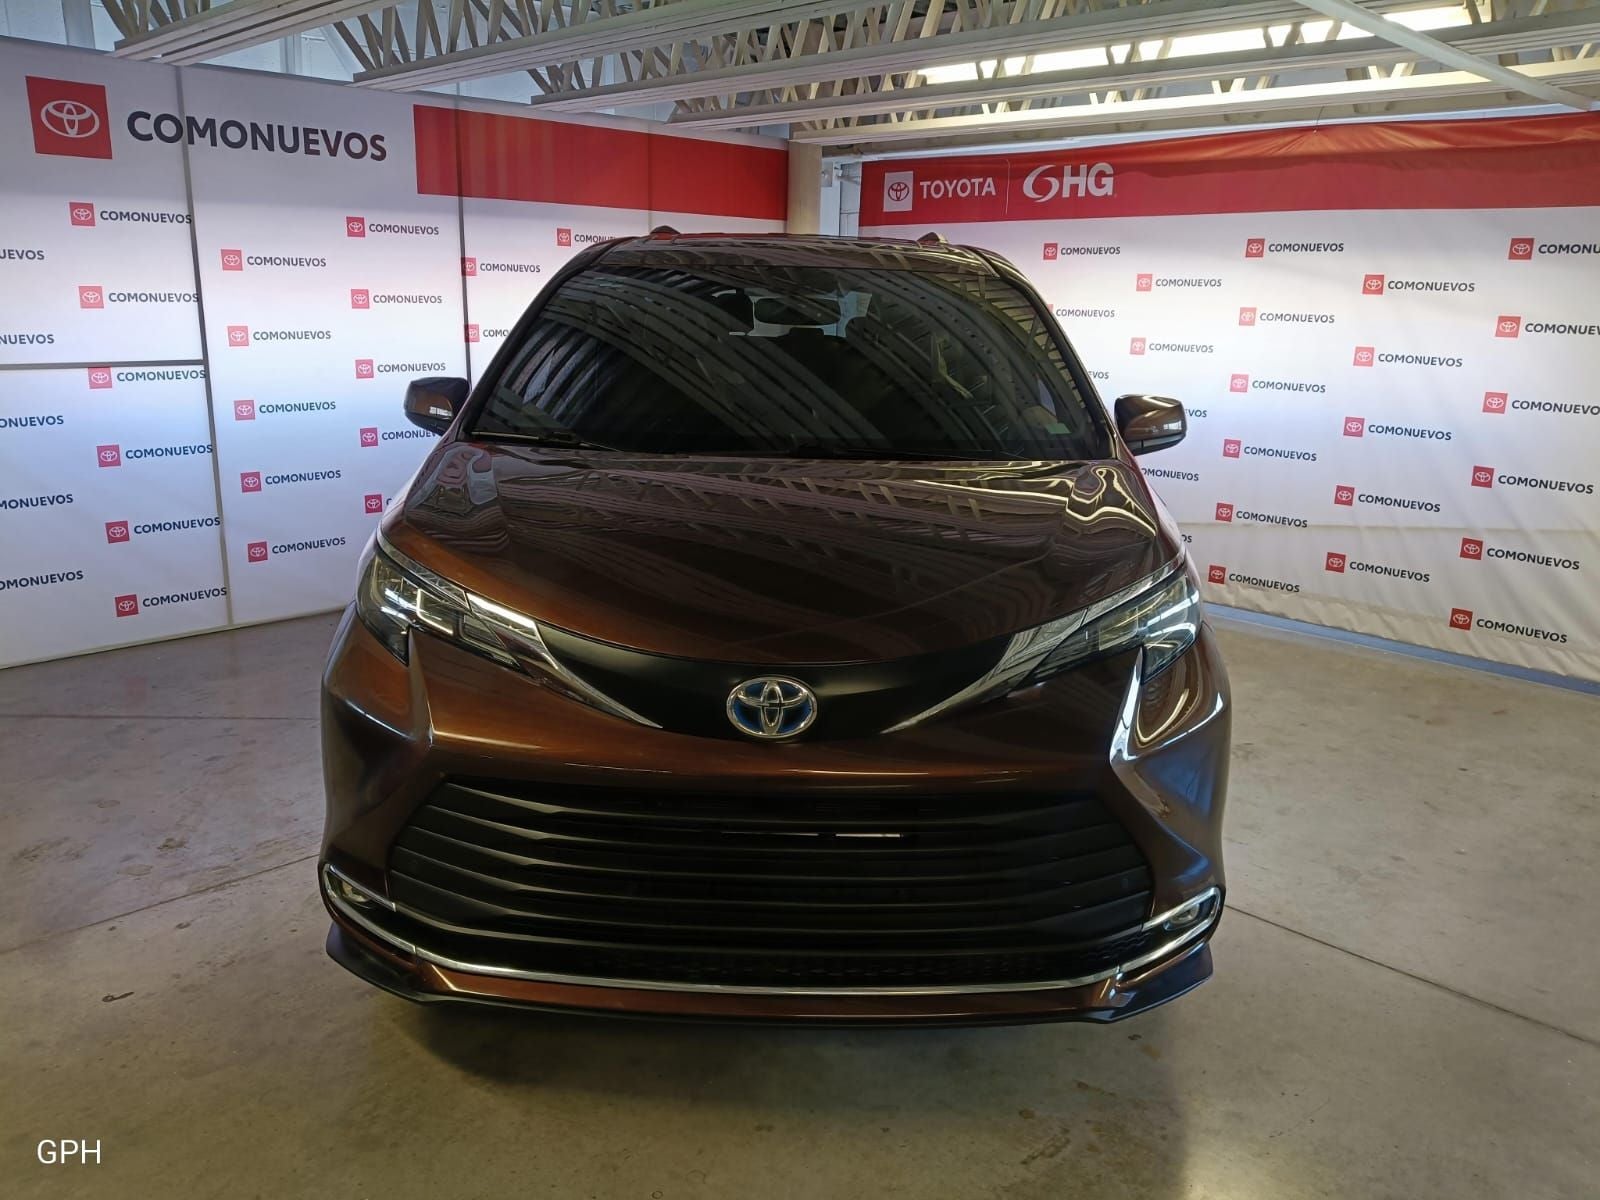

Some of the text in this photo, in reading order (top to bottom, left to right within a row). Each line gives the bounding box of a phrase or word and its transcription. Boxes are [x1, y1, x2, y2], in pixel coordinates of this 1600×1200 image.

[127, 111, 387, 161] COMONUEVOS
[920, 177, 996, 199] TOYOTA
[100, 210, 192, 224] COMONUEVOS
[368, 223, 440, 236] COMONUEVOS
[1060, 246, 1121, 256] COMONUEVOS
[1268, 242, 1345, 253] COMONUEVOS
[246, 255, 327, 268] COMONUEVOS
[479, 262, 541, 273] COMONUEVOS
[1155, 278, 1222, 288] COMONUEVOS
[1387, 280, 1475, 292] COMONUEVOS
[108, 292, 199, 303] COMONUEVOS
[372, 294, 443, 304] COMONUEVOS
[1056, 309, 1115, 318] COMONUEVOS
[1259, 312, 1335, 324] COMONUEVOS
[252, 330, 332, 341] COMONUEVOS
[1149, 343, 1214, 353] COMONUEVOS
[1378, 354, 1462, 367] COMONUEVOS
[377, 362, 446, 373] COMONUEVOS
[116, 369, 206, 382] COMONUEVOS
[1252, 381, 1325, 393] COMONUEVOS
[259, 401, 336, 414] COMONUEVOS
[1512, 400, 1600, 415] COMONUEVO
[1369, 425, 1451, 440] COMONUEVOS
[125, 444, 213, 460] COMONUEVOS
[1244, 447, 1316, 461] COMONUEVOS
[265, 469, 341, 485] COMONUEVOS
[1498, 475, 1593, 494] COMONUEVOS
[1359, 494, 1440, 512] COMONUEVOS
[133, 516, 221, 534] COMONUEVOS
[1236, 511, 1307, 528] COMONUEVOS
[272, 537, 345, 554] COMONUEVOS
[1487, 548, 1579, 569] COMONUEVOS
[1350, 562, 1429, 582] COMONUEVOS
[1229, 574, 1299, 592] COMONUEVOS
[142, 586, 227, 608] COMONUEVOS
[1477, 619, 1567, 643] COMONUEVOS
